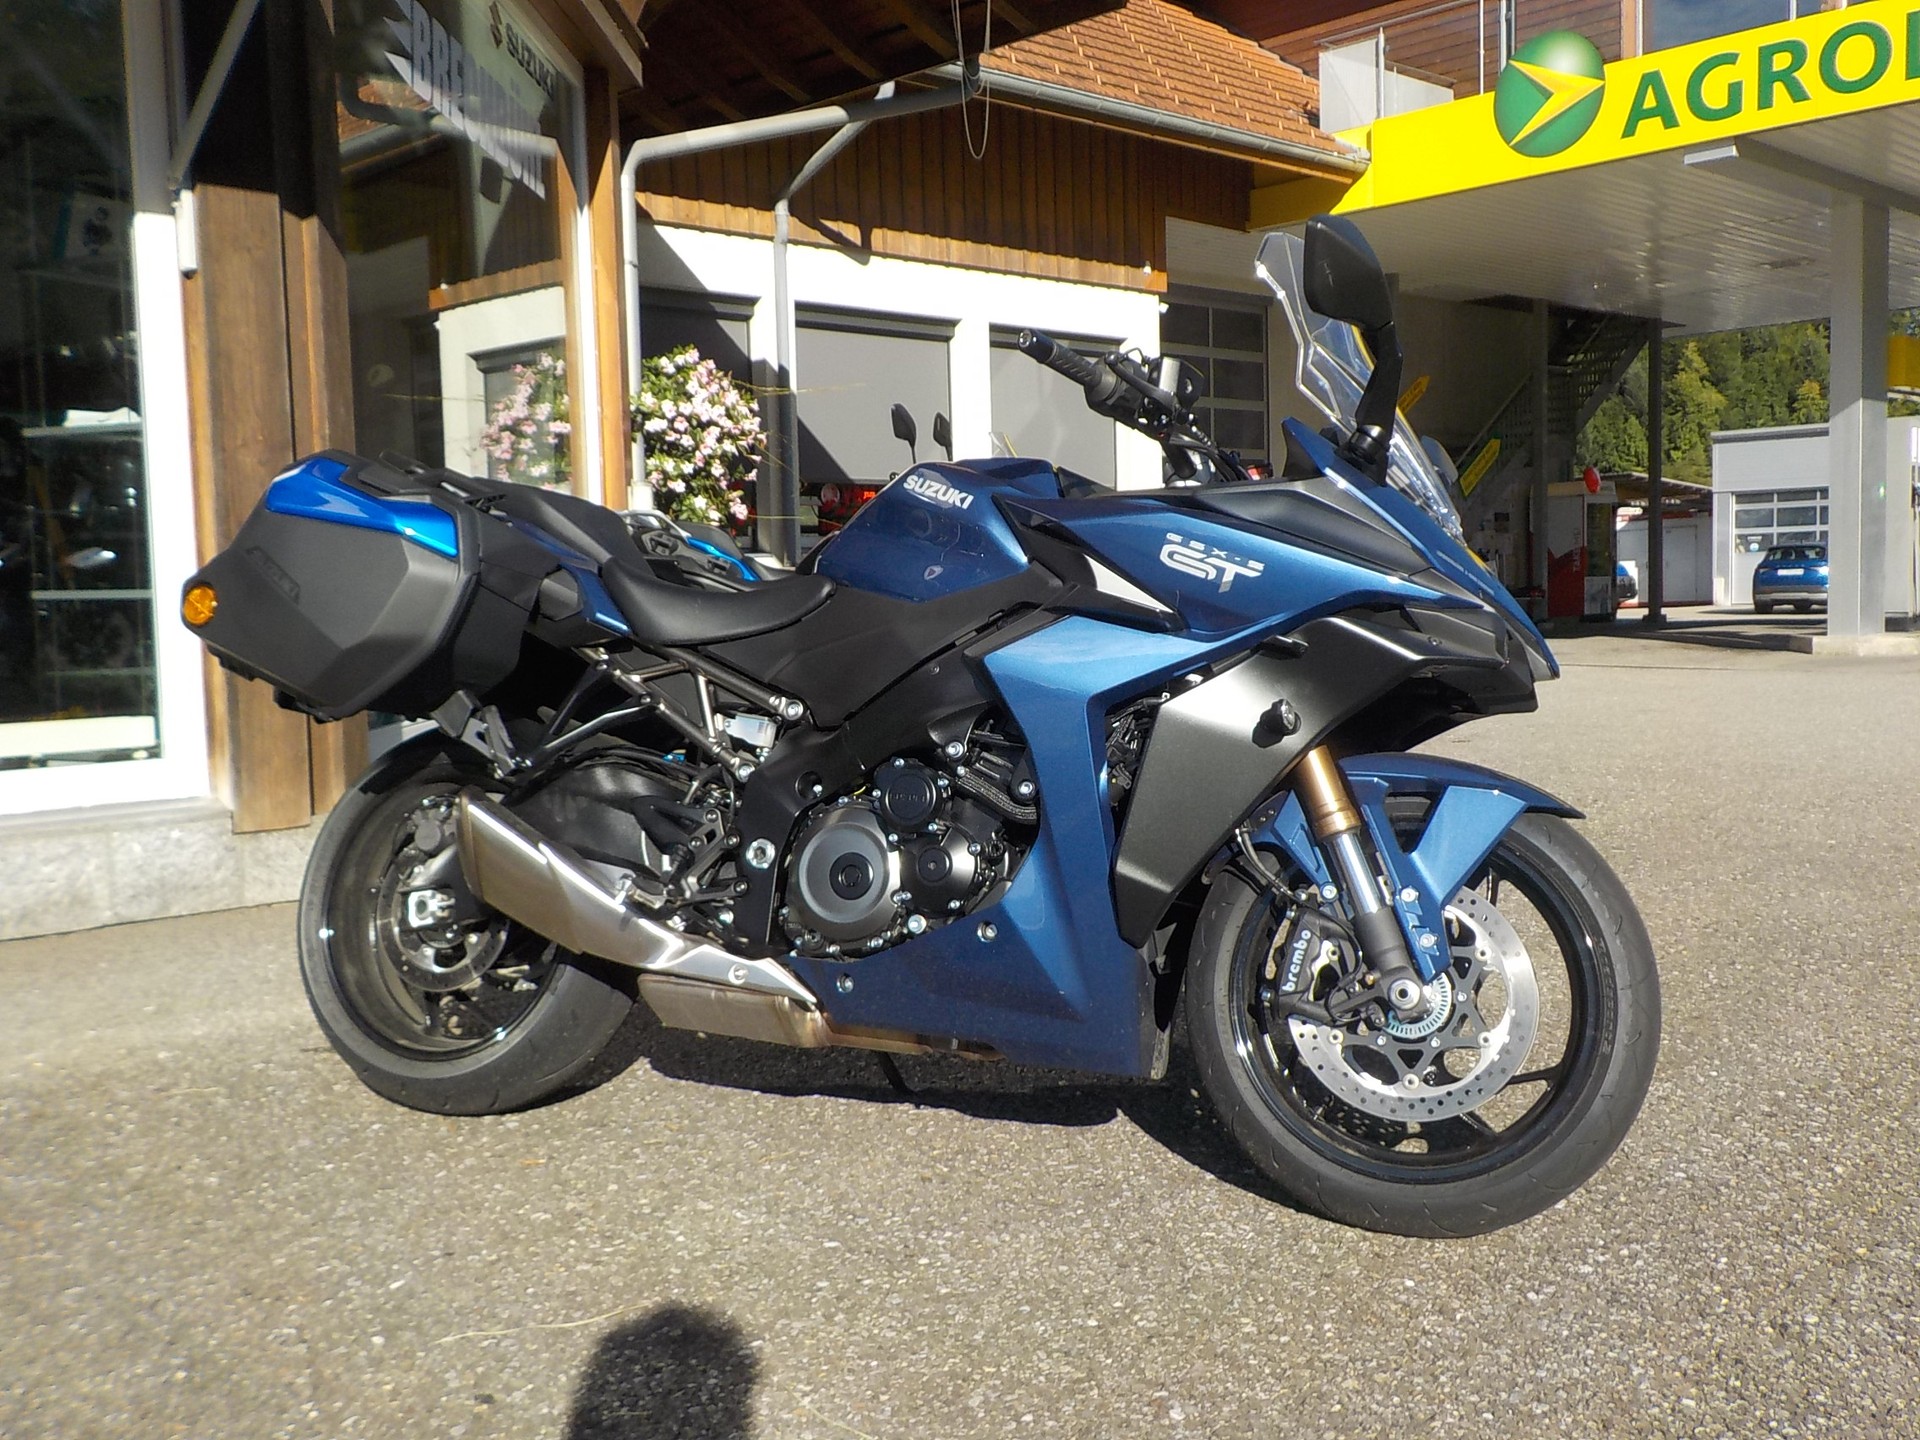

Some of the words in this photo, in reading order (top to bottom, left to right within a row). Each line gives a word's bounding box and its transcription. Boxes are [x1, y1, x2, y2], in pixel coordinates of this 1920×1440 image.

[506, 22, 554, 100] SUZUKI
[903, 474, 975, 510] SUZUKI
[1160, 543, 1262, 593] GT
[1281, 929, 1312, 992] brembo
